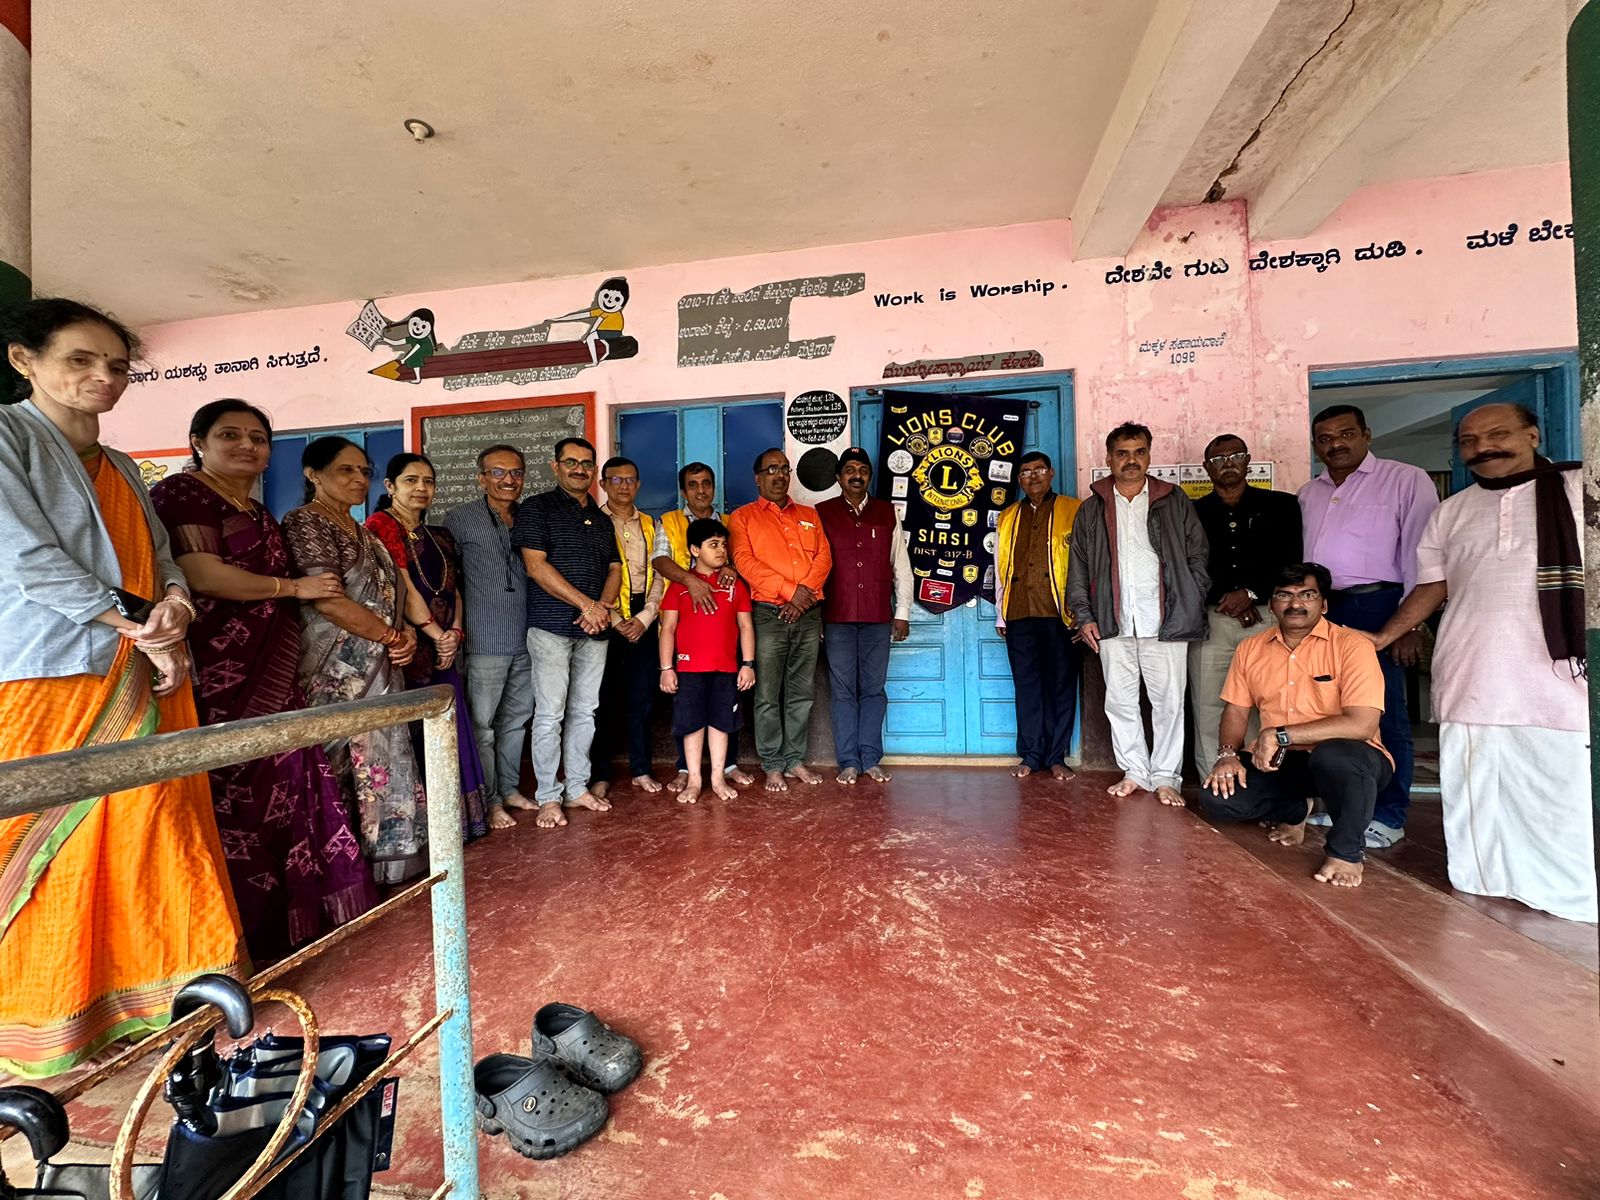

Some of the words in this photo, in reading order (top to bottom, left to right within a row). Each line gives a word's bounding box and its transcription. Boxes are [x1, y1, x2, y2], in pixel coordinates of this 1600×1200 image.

[1466, 223, 1518, 249] ಮಳೆ
[1105, 261, 1172, 284] ದೇಶವೇ
[1249, 248, 1341, 274] ದೇಶಕ್ಕಾಗಿ
[873, 291, 924, 307] Work
[939, 288, 956, 301] is
[164, 363, 207, 382] ಯಶಸ್ಸು
[214, 357, 259, 374] ತಾನಾಗಿ
[1169, 351, 1195, 365] 1098
[887, 409, 952, 446] LIONS
[961, 412, 1015, 456] CLUB
[930, 447, 972, 466] LIONS
[941, 465, 958, 490] L
[918, 528, 969, 546] SIRSI
[913, 547, 937, 556] DIST
[384, 1084, 393, 1110] WOLF
